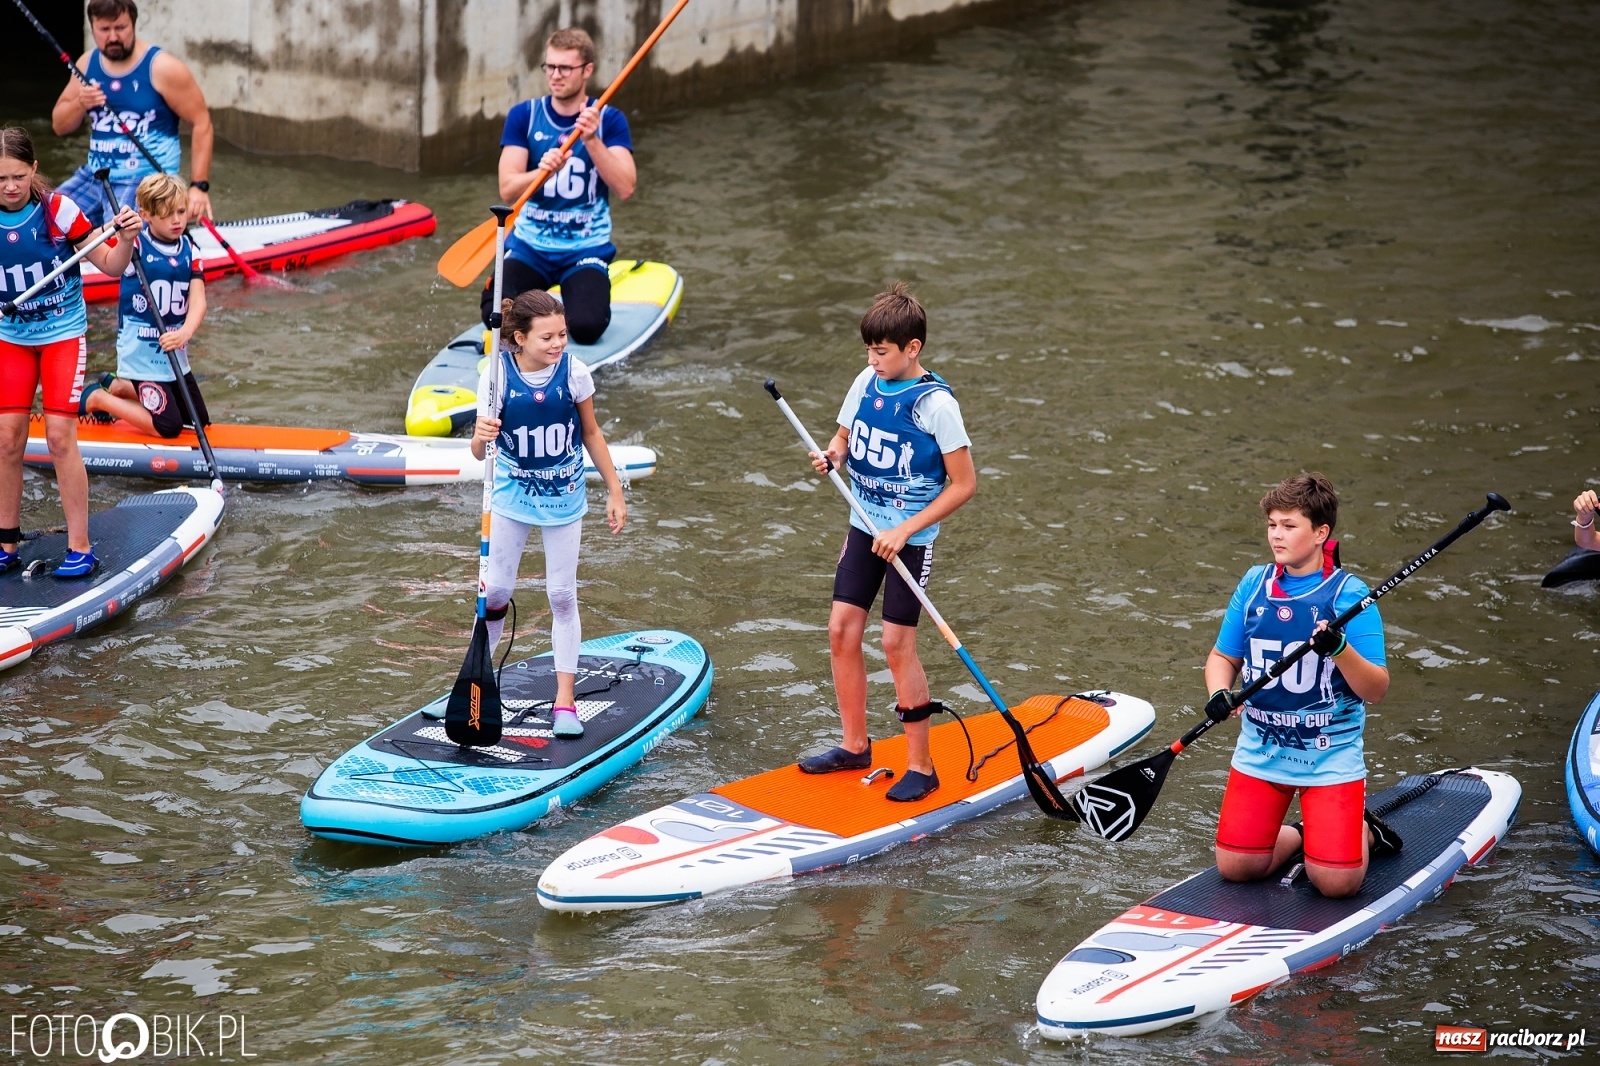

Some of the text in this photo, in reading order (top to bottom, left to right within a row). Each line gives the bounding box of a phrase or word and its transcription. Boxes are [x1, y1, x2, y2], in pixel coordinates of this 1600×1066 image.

[512, 422, 566, 458] 110
[850, 419, 899, 469] 65
[534, 469, 556, 480] SUP
[559, 463, 577, 478] CUP
[884, 482, 910, 494] CUP
[1376, 576, 1401, 597] AQUA
[1402, 548, 1438, 576] MARINA
[1250, 638, 1319, 694] 50
[1272, 712, 1301, 728] SUP
[1305, 712, 1334, 728] CUP
[1256, 750, 1316, 766] AQUA MARINA
